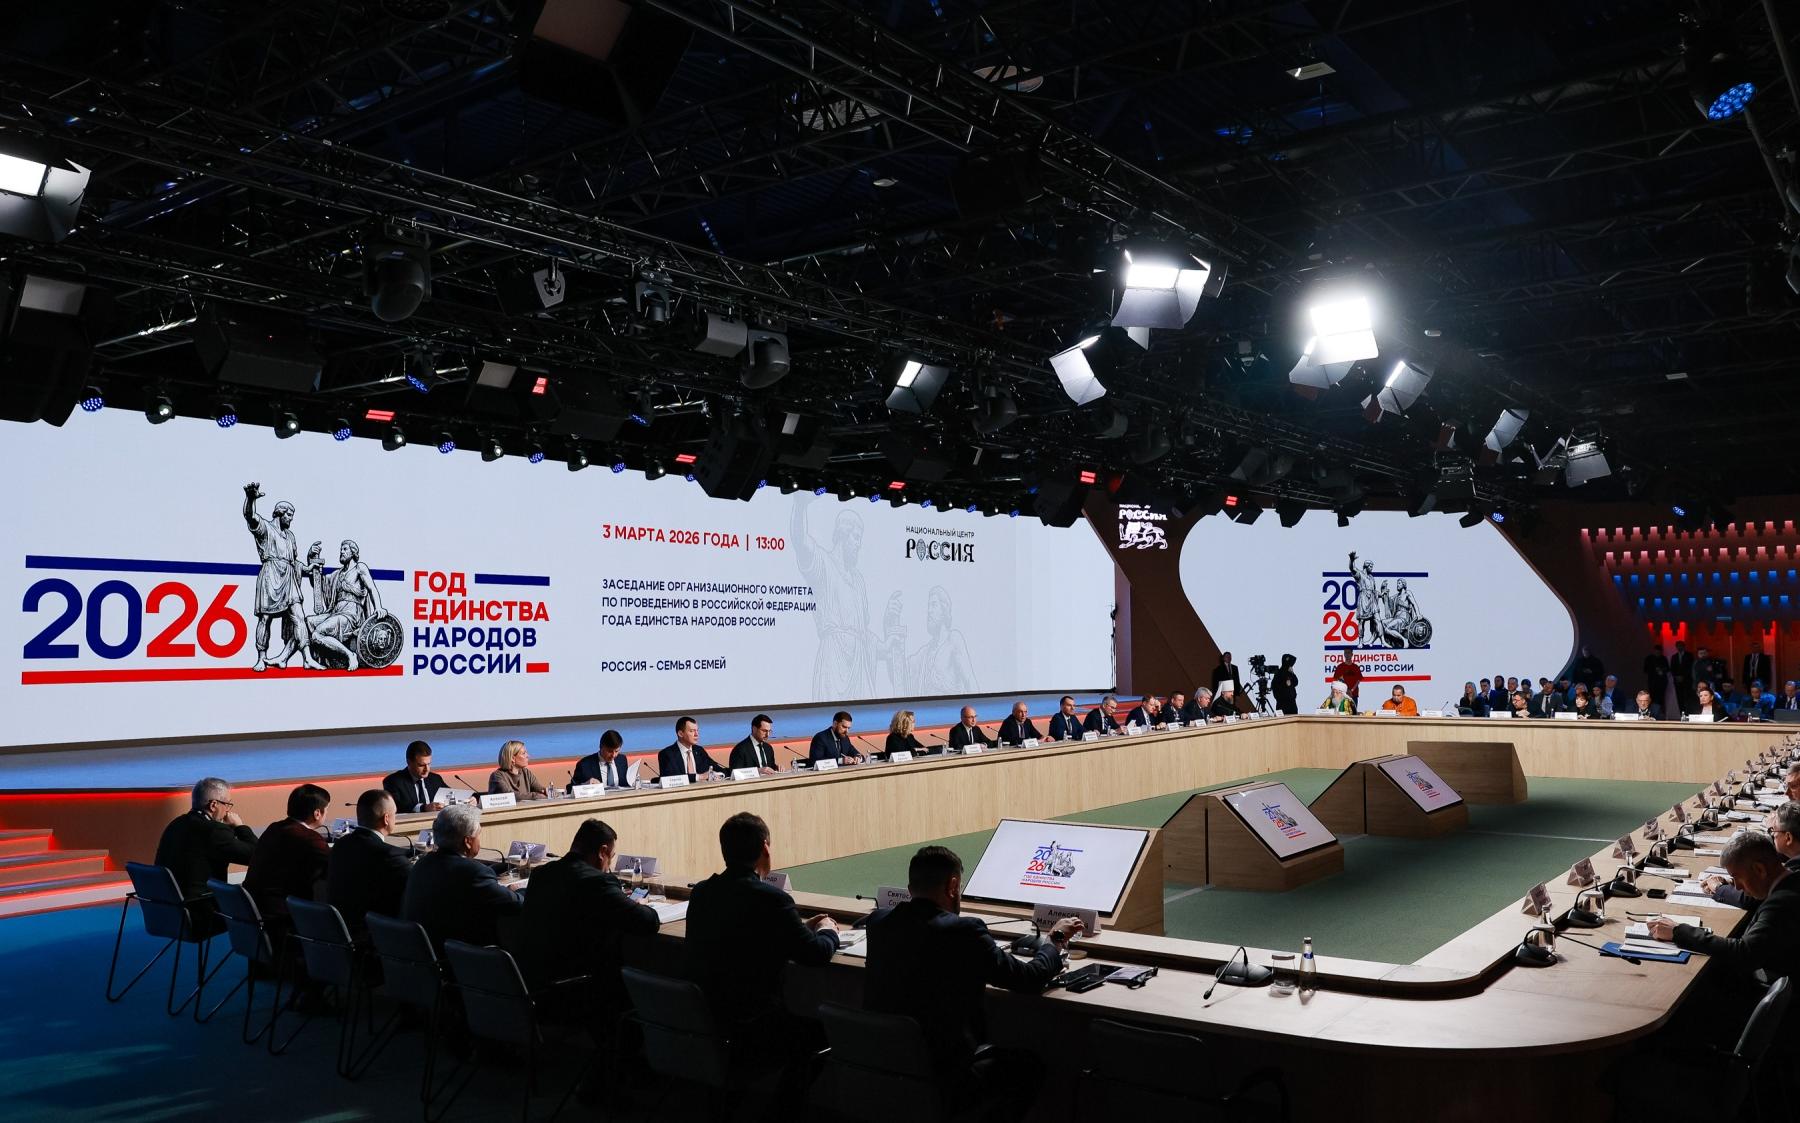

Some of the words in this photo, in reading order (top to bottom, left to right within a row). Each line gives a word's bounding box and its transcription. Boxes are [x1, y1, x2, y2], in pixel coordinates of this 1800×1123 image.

[602, 524, 611, 539] 3
[615, 525, 665, 542] МАРТА
[669, 529, 700, 545] 2026
[703, 532, 740, 549] ГОДА
[756, 536, 785, 551] 13:00
[906, 525, 956, 537] НАЦИОНАЛЬНЫЙ
[957, 530, 975, 539] ЦЕНТР
[905, 538, 975, 562] РОССИЯ
[413, 571, 467, 597] ГОД
[602, 579, 665, 591] ЗАСЕДАНИЕ
[667, 581, 767, 594] ОРГАНИЗАЦИОННОГО
[769, 585, 813, 596] КОМИТЕТА
[602, 597, 618, 607] ПО
[620, 597, 690, 610] ПРОВЕДЕНИЮ
[692, 599, 699, 609] В
[701, 597, 764, 610] РОССИЙСКОЙ
[765, 601, 816, 612] ФЕДЕРАЦИИ
[1322, 580, 1360, 611] 20
[22, 578, 248, 660] 2026
[413, 600, 550, 624] ЕДИНСТВА
[602, 615, 632, 627] ГОДА
[634, 615, 689, 627] ЕДИНСТВА
[691, 616, 737, 627] НАРОДОВ
[739, 616, 776, 627] РОССИИ
[1322, 611, 1359, 642] 26
[413, 627, 537, 651] НАРОДОВ
[413, 653, 521, 676] РОССИИ
[601, 660, 647, 672] РОССИЯ
[656, 660, 691, 671] СЕМЬЯ
[693, 656, 726, 670] СЕМЕЙ
[1324, 654, 1344, 663] ГОД
[1351, 653, 1398, 663] ДИНСТВА
[1324, 664, 1372, 673] НАОВ
[1374, 663, 1414, 672] РОССИИ
[1033, 849, 1051, 861] 20
[1027, 860, 1044, 871] 26
